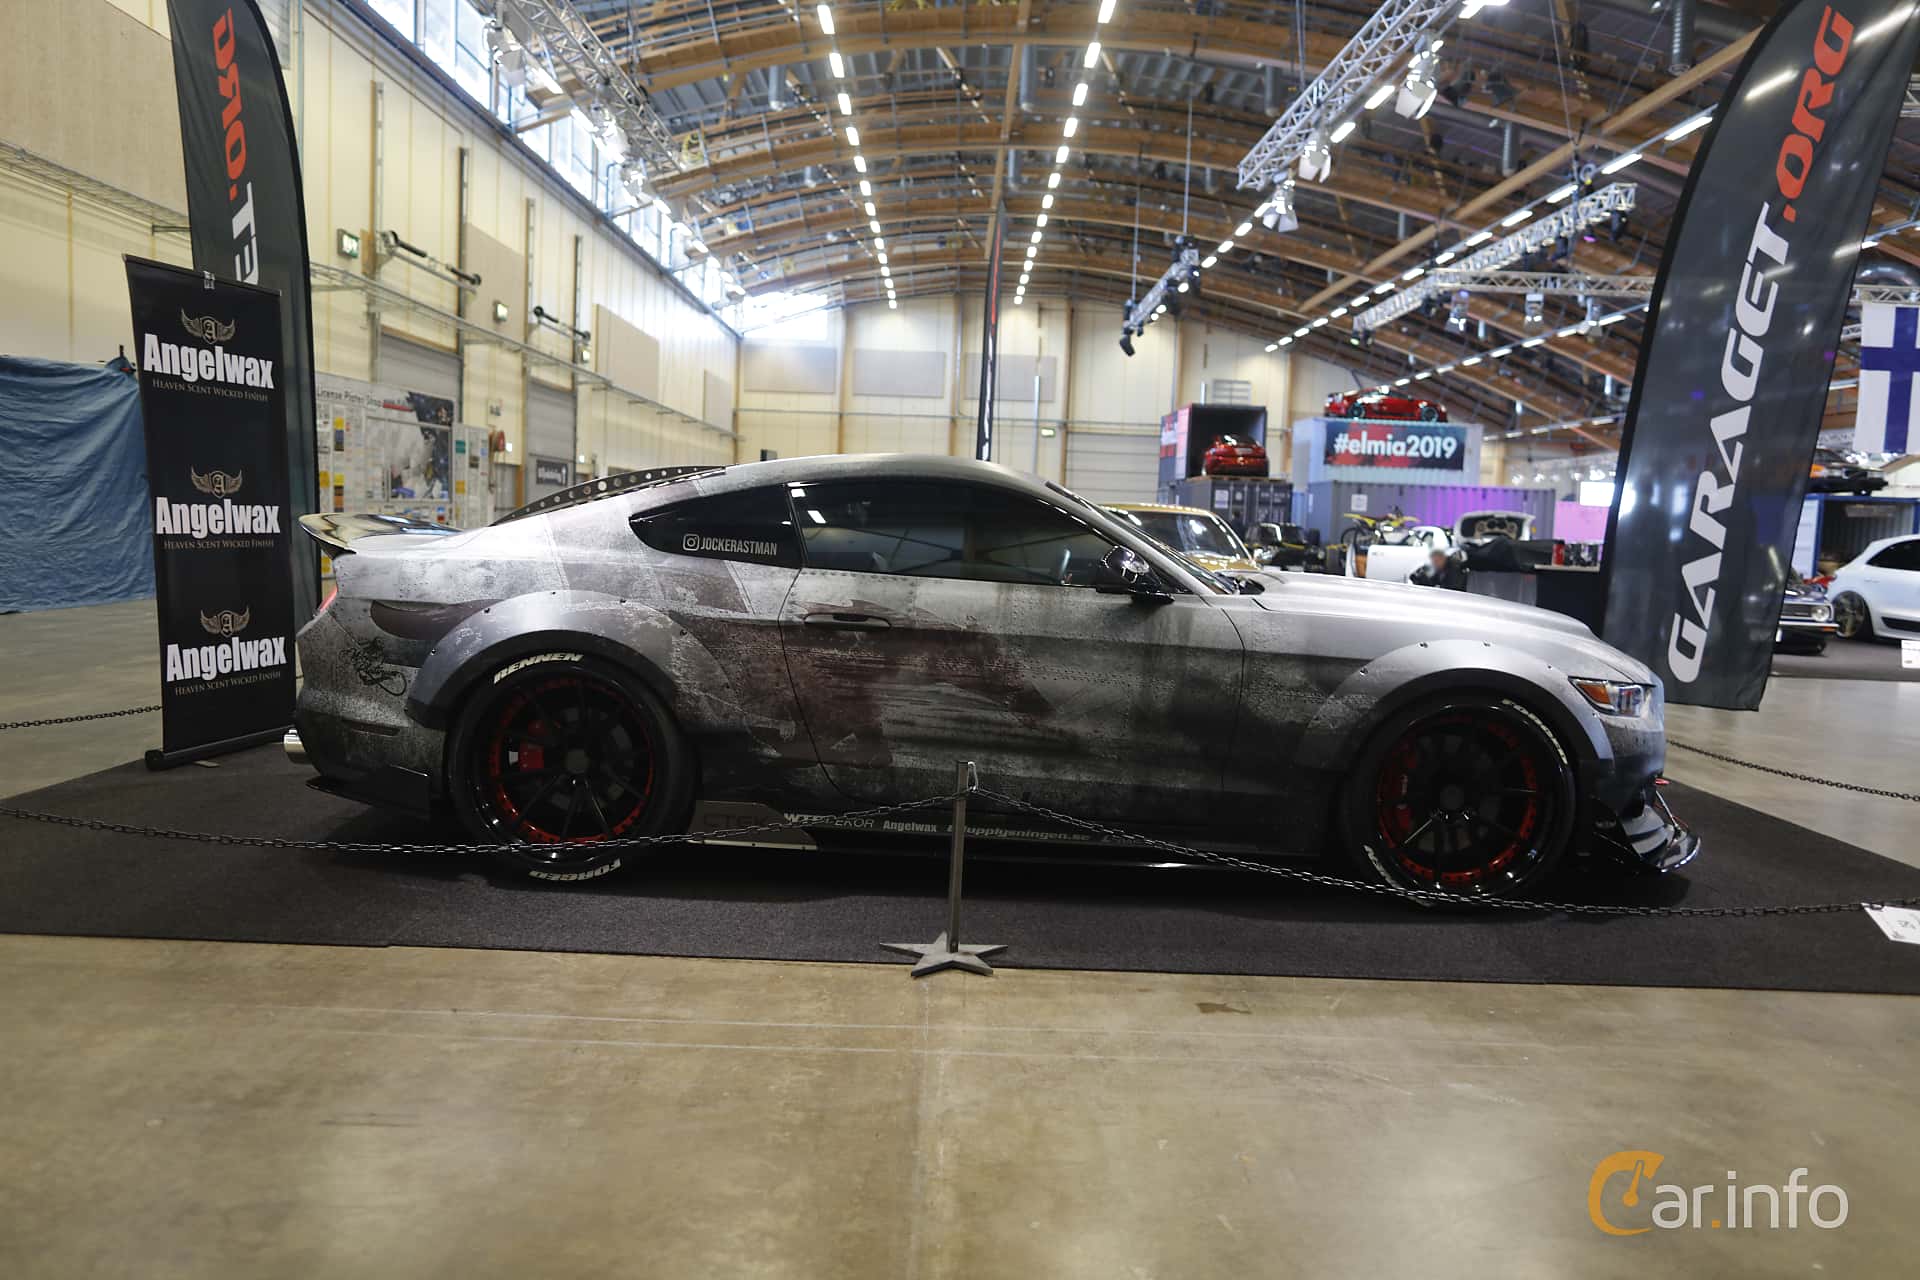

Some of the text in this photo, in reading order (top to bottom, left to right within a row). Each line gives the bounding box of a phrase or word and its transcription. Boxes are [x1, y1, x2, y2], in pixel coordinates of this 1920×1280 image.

[143, 333, 275, 389] Angelwax
[1668, 4, 1855, 683] GARAGET.ORG
[1334, 431, 1457, 458] #elmia2019
[156, 497, 281, 539] Angelwax
[700, 537, 778, 556] JOCKERASTMAN
[166, 636, 287, 682] Angelwax
[494, 652, 585, 685] RENNEN
[883, 820, 937, 833] Angelwax
